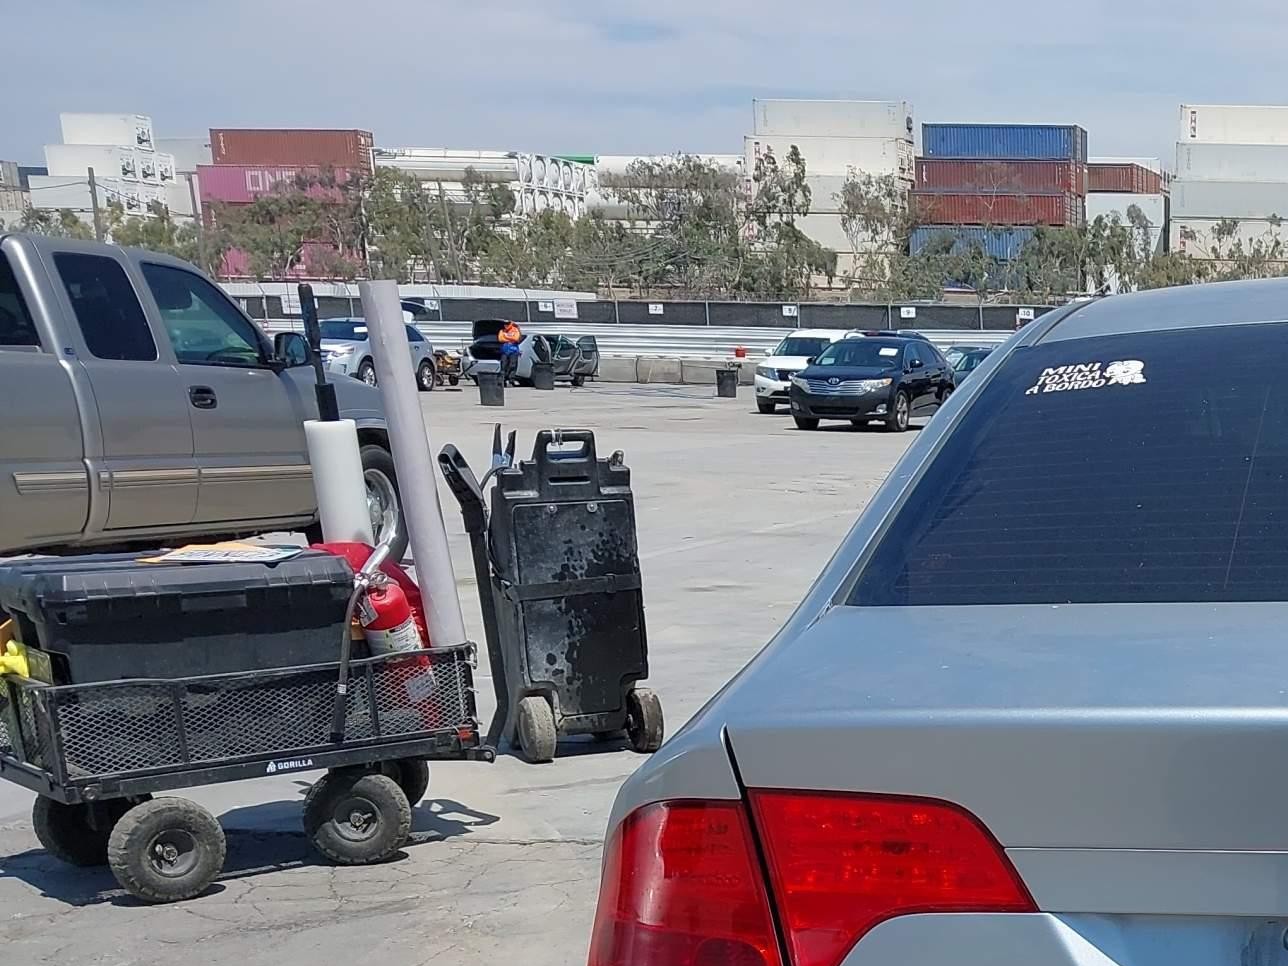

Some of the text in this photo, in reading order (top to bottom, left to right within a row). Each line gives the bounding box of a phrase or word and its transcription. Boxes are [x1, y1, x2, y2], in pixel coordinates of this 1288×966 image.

[1041, 362, 1102, 376] MINI
[1037, 370, 1101, 386] TOXICA
[1025, 378, 1106, 395] A BORDO
[277, 759, 313, 770] GORILLA
